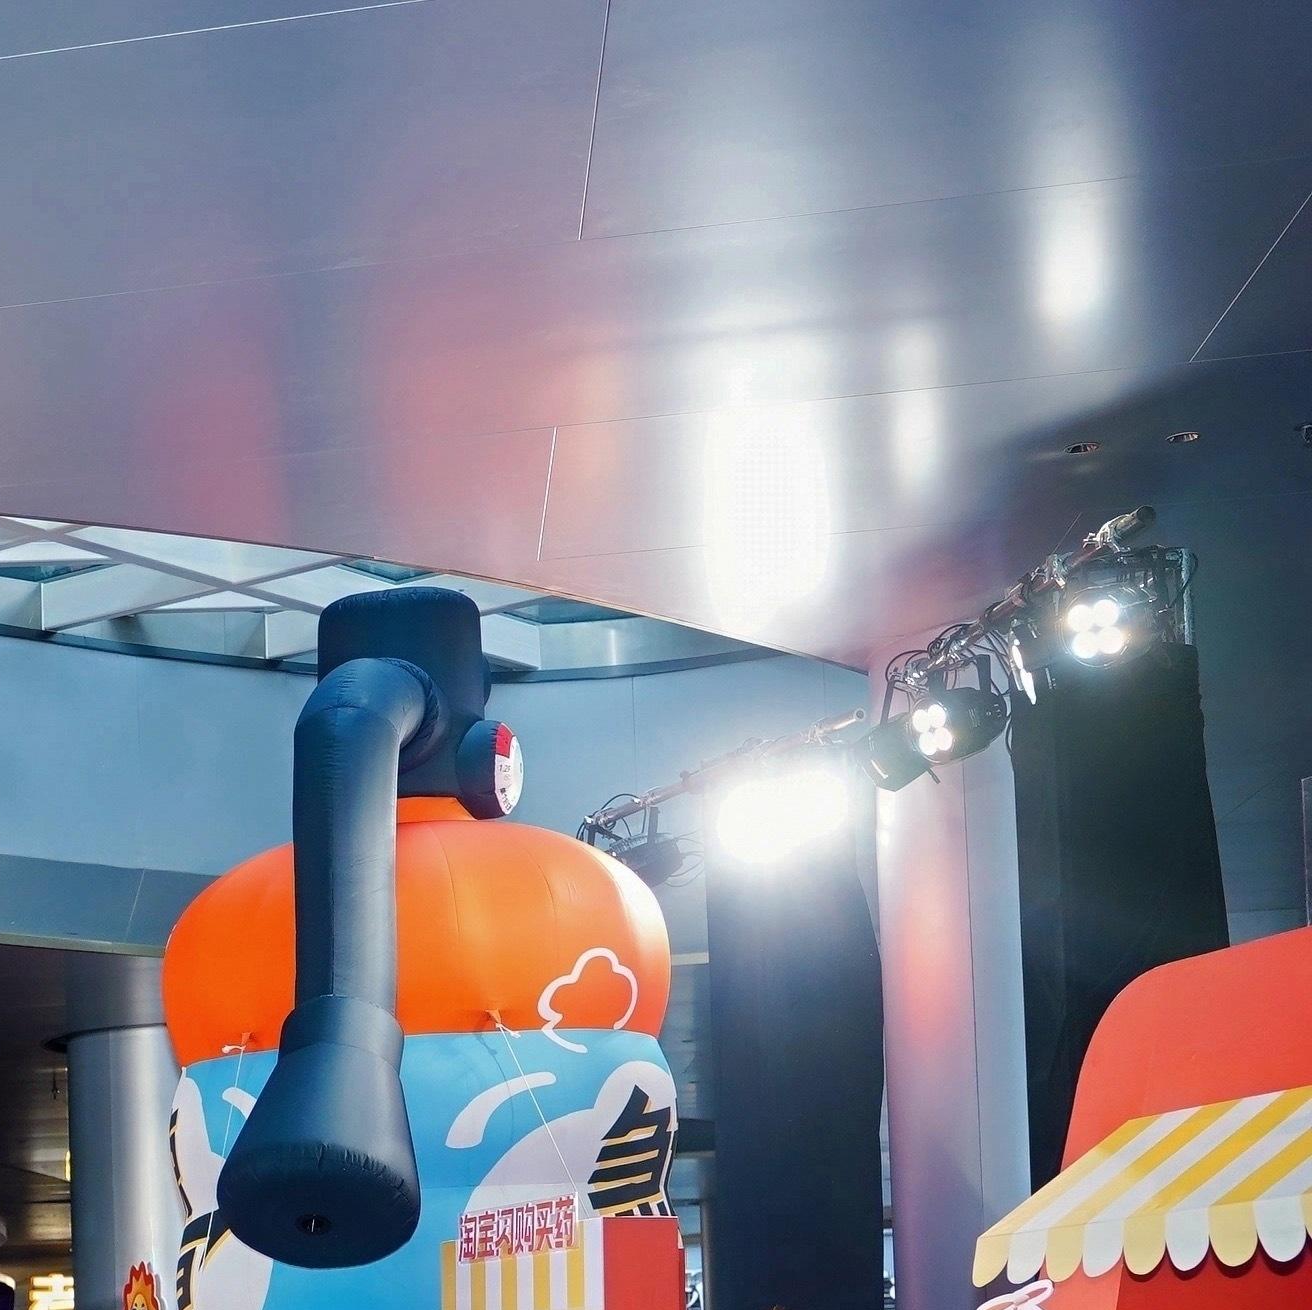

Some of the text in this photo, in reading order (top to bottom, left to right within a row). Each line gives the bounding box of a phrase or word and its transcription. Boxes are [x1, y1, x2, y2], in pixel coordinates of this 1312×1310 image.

[458, 1195, 577, 1264] 淘宝闪购买药
